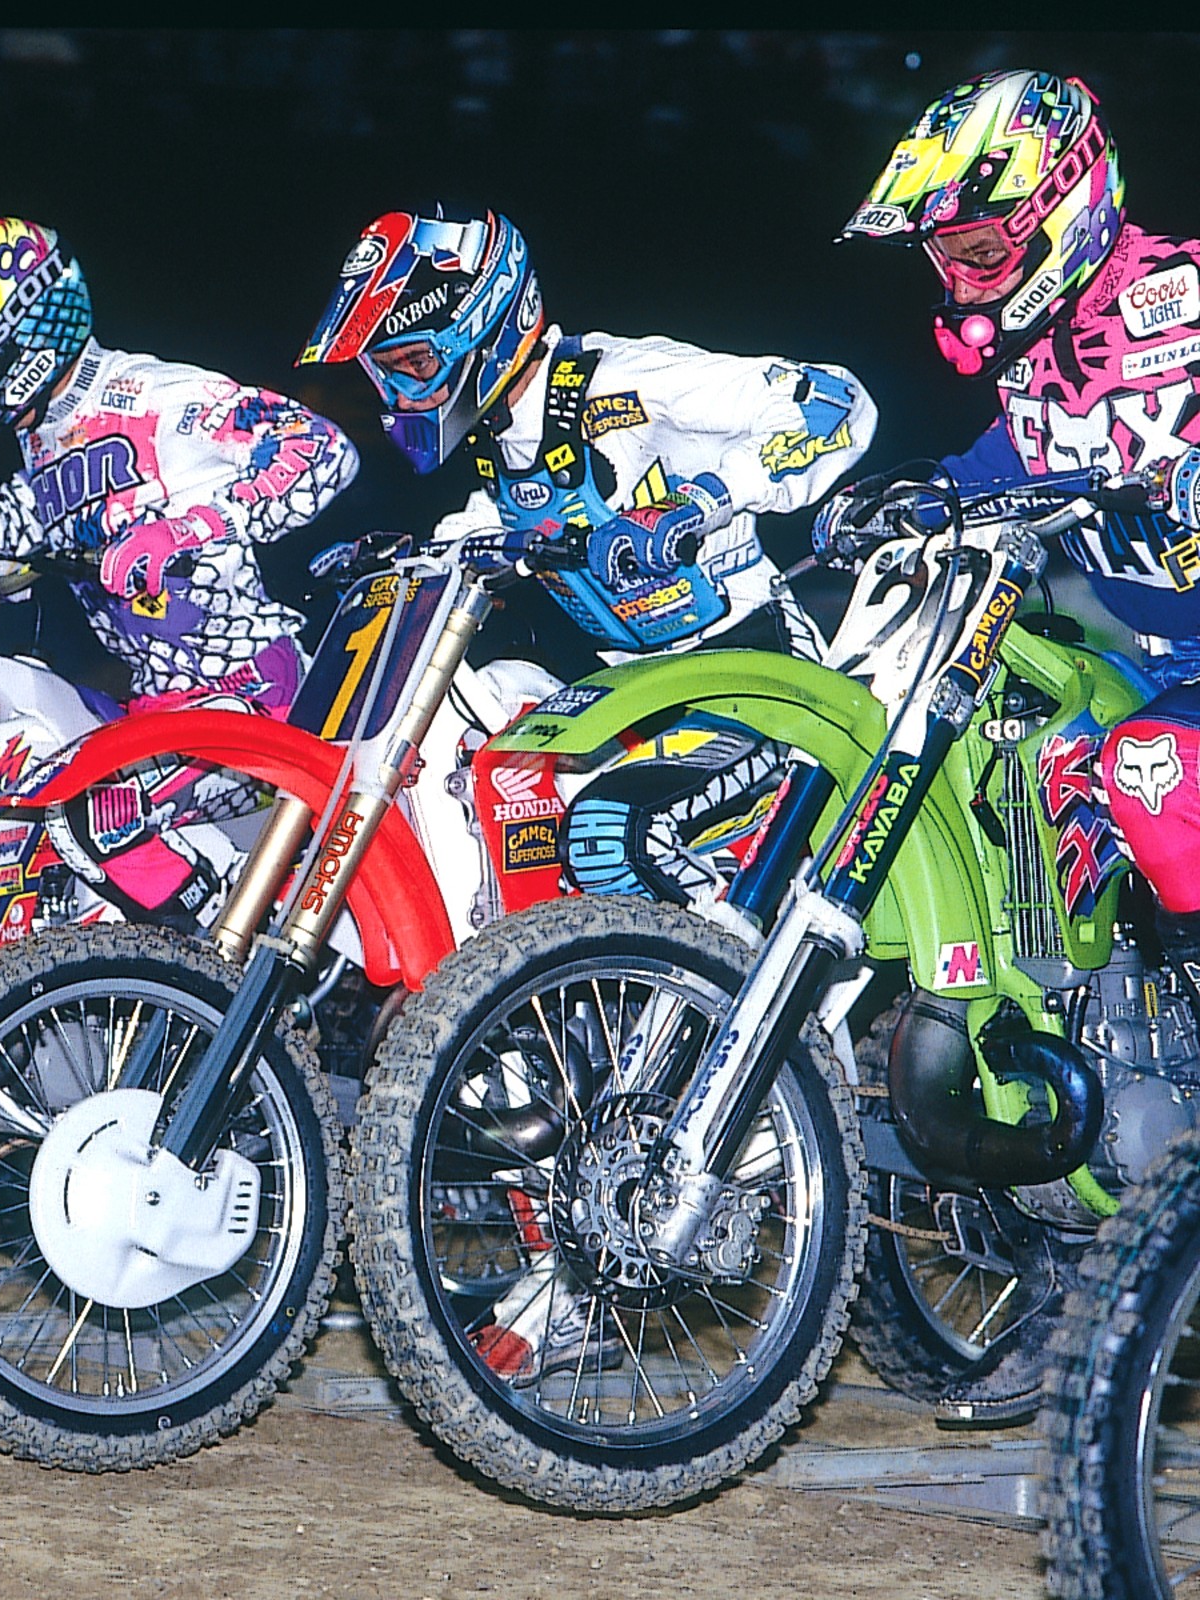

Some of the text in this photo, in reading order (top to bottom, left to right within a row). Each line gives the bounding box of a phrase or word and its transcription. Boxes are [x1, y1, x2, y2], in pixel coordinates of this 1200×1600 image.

[1008, 115, 1106, 246] SCOTT
[385, 283, 449, 336] OXBOW
[1010, 275, 1058, 323] SHOEI
[1126, 275, 1189, 310] Coors
[1140, 300, 1182, 330] LIGHT
[9, 353, 52, 401] SHOEI
[74, 357, 101, 392] THOR
[100, 391, 138, 412] LIGHT
[513, 484, 547, 503] Arai
[970, 590, 1017, 671] CAMEL
[319, 606, 393, 741] 1
[91, 785, 139, 835] THOR
[493, 797, 567, 822] HONDA
[848, 764, 921, 884] KAYABA
[508, 824, 556, 850] CAMEL
[508, 847, 556, 865] SUPERCROSS
[301, 810, 364, 915] SHOWA
[1, 926, 26, 942] NGK
